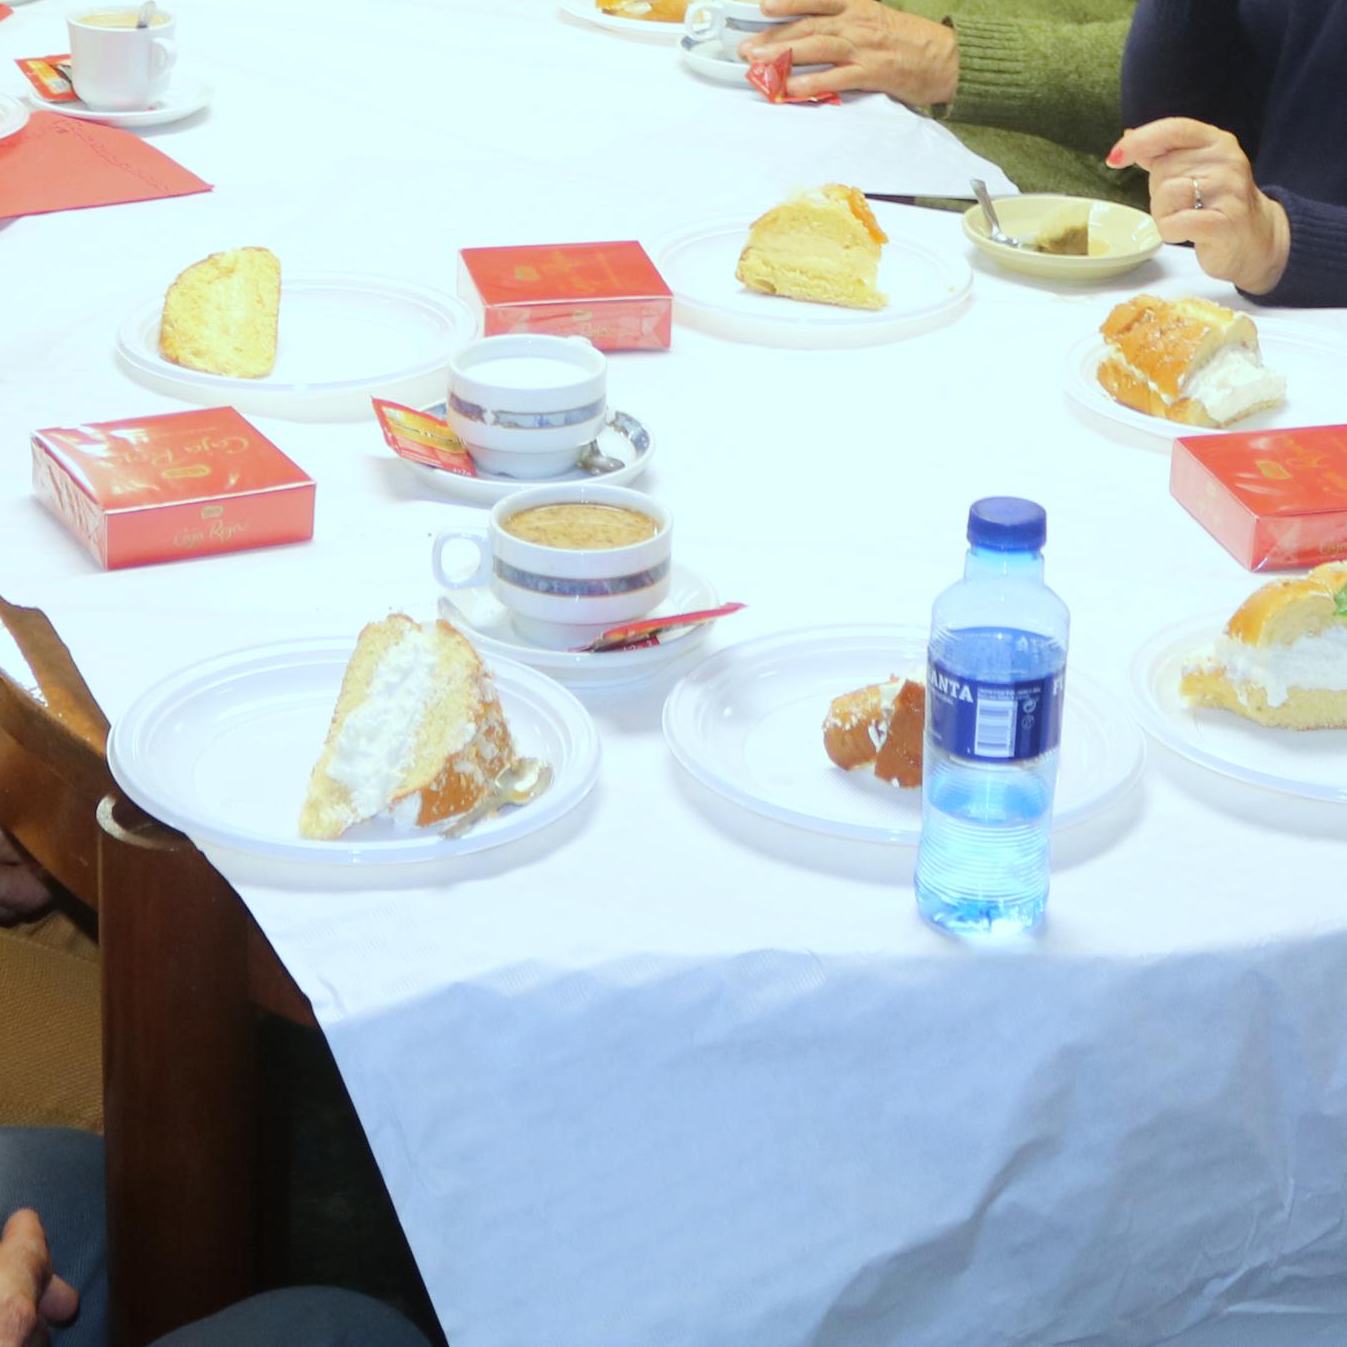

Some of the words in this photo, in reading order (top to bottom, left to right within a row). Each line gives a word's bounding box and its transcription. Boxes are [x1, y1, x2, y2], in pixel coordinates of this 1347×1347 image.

[173, 527, 204, 550] Caja
[208, 519, 249, 542] Roja
[929, 669, 975, 704] ANTA
